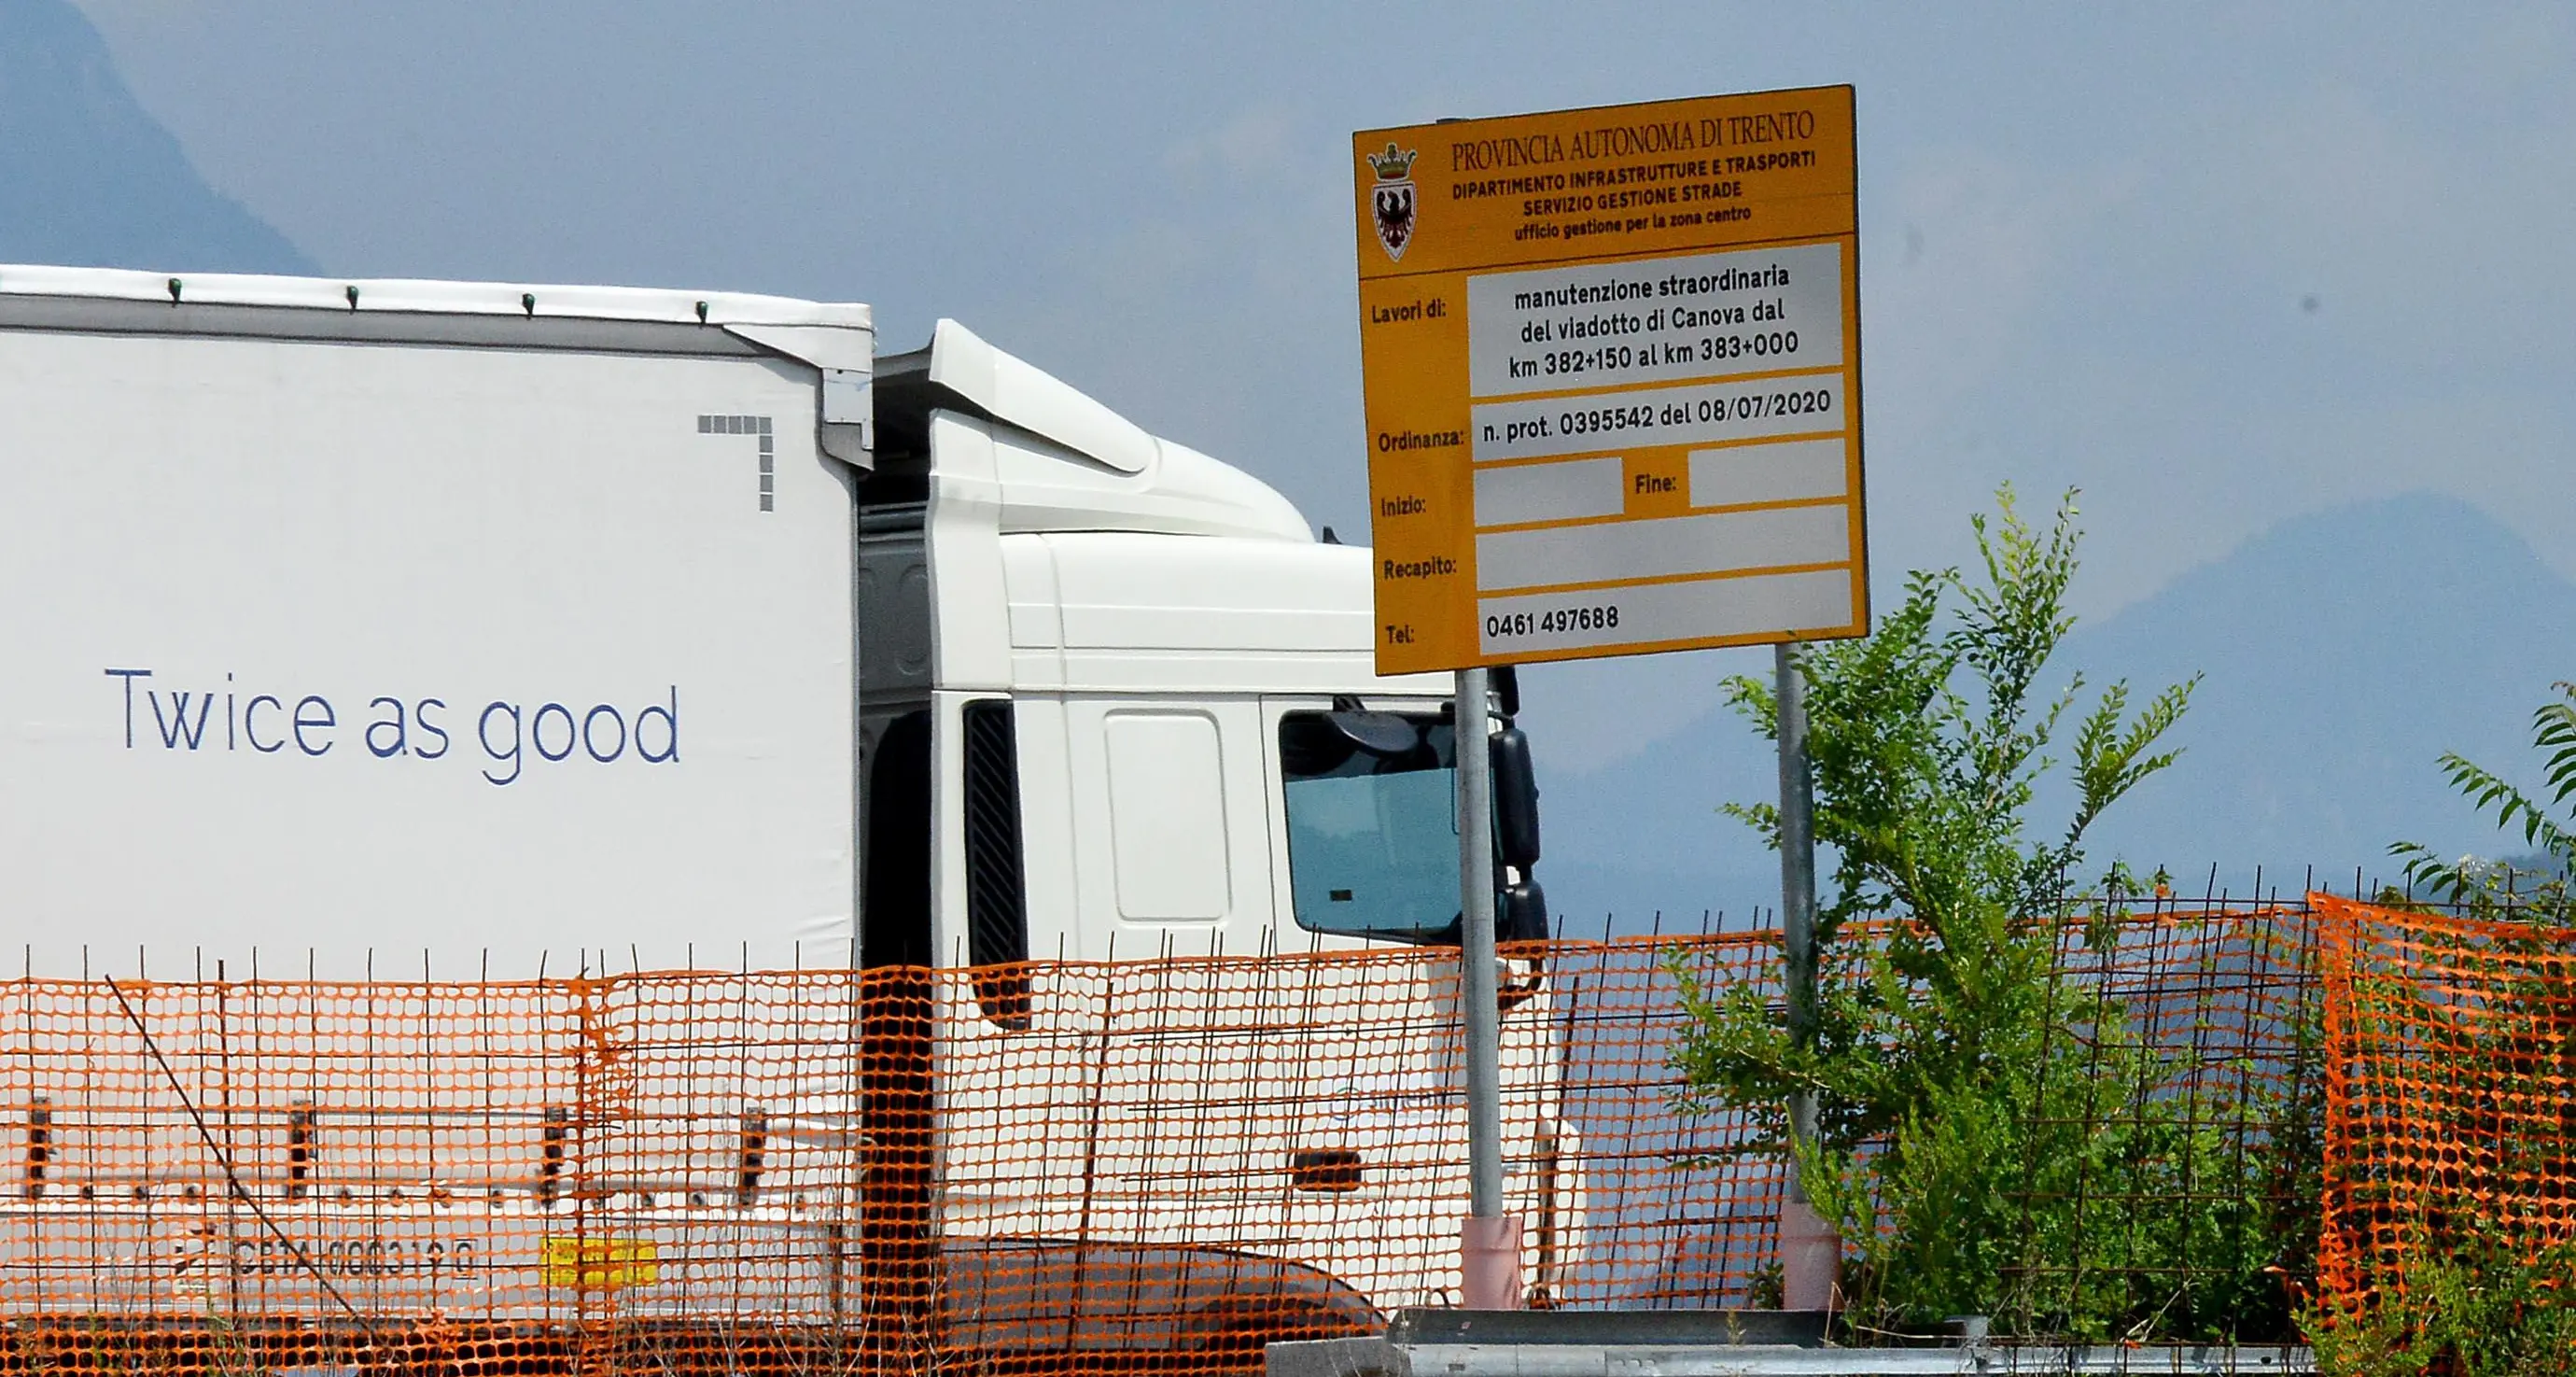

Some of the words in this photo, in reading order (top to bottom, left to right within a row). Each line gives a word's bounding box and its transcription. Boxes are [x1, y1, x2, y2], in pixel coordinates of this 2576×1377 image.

[1451, 133, 1565, 172] PROVINCIA
[1570, 121, 1696, 161] AUTONOMA
[1701, 119, 1723, 148] DI
[1729, 109, 1815, 146] TRENTO
[1452, 174, 1565, 200] DIPARTIMENTO
[1570, 160, 1707, 187] INFRASTRUTTURE
[1712, 159, 1722, 176] E
[1726, 150, 1815, 174] TRASPORTI
[1523, 196, 1593, 217] SERVIZIO
[1597, 187, 1677, 210] GESTIONE
[1682, 181, 1743, 202] STRADE
[1514, 222, 1560, 241] ufficio
[1563, 218, 1621, 240] gestione
[1626, 217, 1649, 233] per
[1653, 213, 1666, 229] la
[1670, 212, 1702, 228] zona
[1706, 204, 1752, 224] centro
[1515, 278, 1652, 310] manutenzione
[1659, 263, 1789, 296] straordinaria
[1372, 300, 1421, 323] Lavori
[1426, 298, 1447, 317] di:
[1521, 319, 1551, 343] del
[1559, 314, 1640, 339] viadotto
[1646, 309, 1664, 331] di
[1672, 306, 1744, 329] Canova
[1753, 298, 1785, 321] dal
[1509, 357, 1537, 378] km
[1545, 345, 1631, 374] 382+150
[1638, 344, 1658, 366] al
[1664, 343, 1693, 364] km
[1701, 330, 1799, 360] 383+000
[1483, 423, 1501, 442] n.
[1506, 420, 1553, 444] prot.
[1561, 405, 1654, 435] 0395542
[1659, 402, 1691, 426] del
[1698, 389, 1831, 422] 08/07/2020
[1379, 429, 1464, 452] Ordinanza:
[1635, 474, 1677, 495] Fine:
[1381, 496, 1427, 516] Inizio:
[1384, 555, 1457, 580] Recapito:
[1385, 625, 1415, 644] Tel:
[1487, 613, 1533, 638] 0461
[1541, 606, 1618, 633] 497688
[104, 667, 337, 756] Twice
[364, 696, 450, 759] as
[478, 684, 680, 786] good
